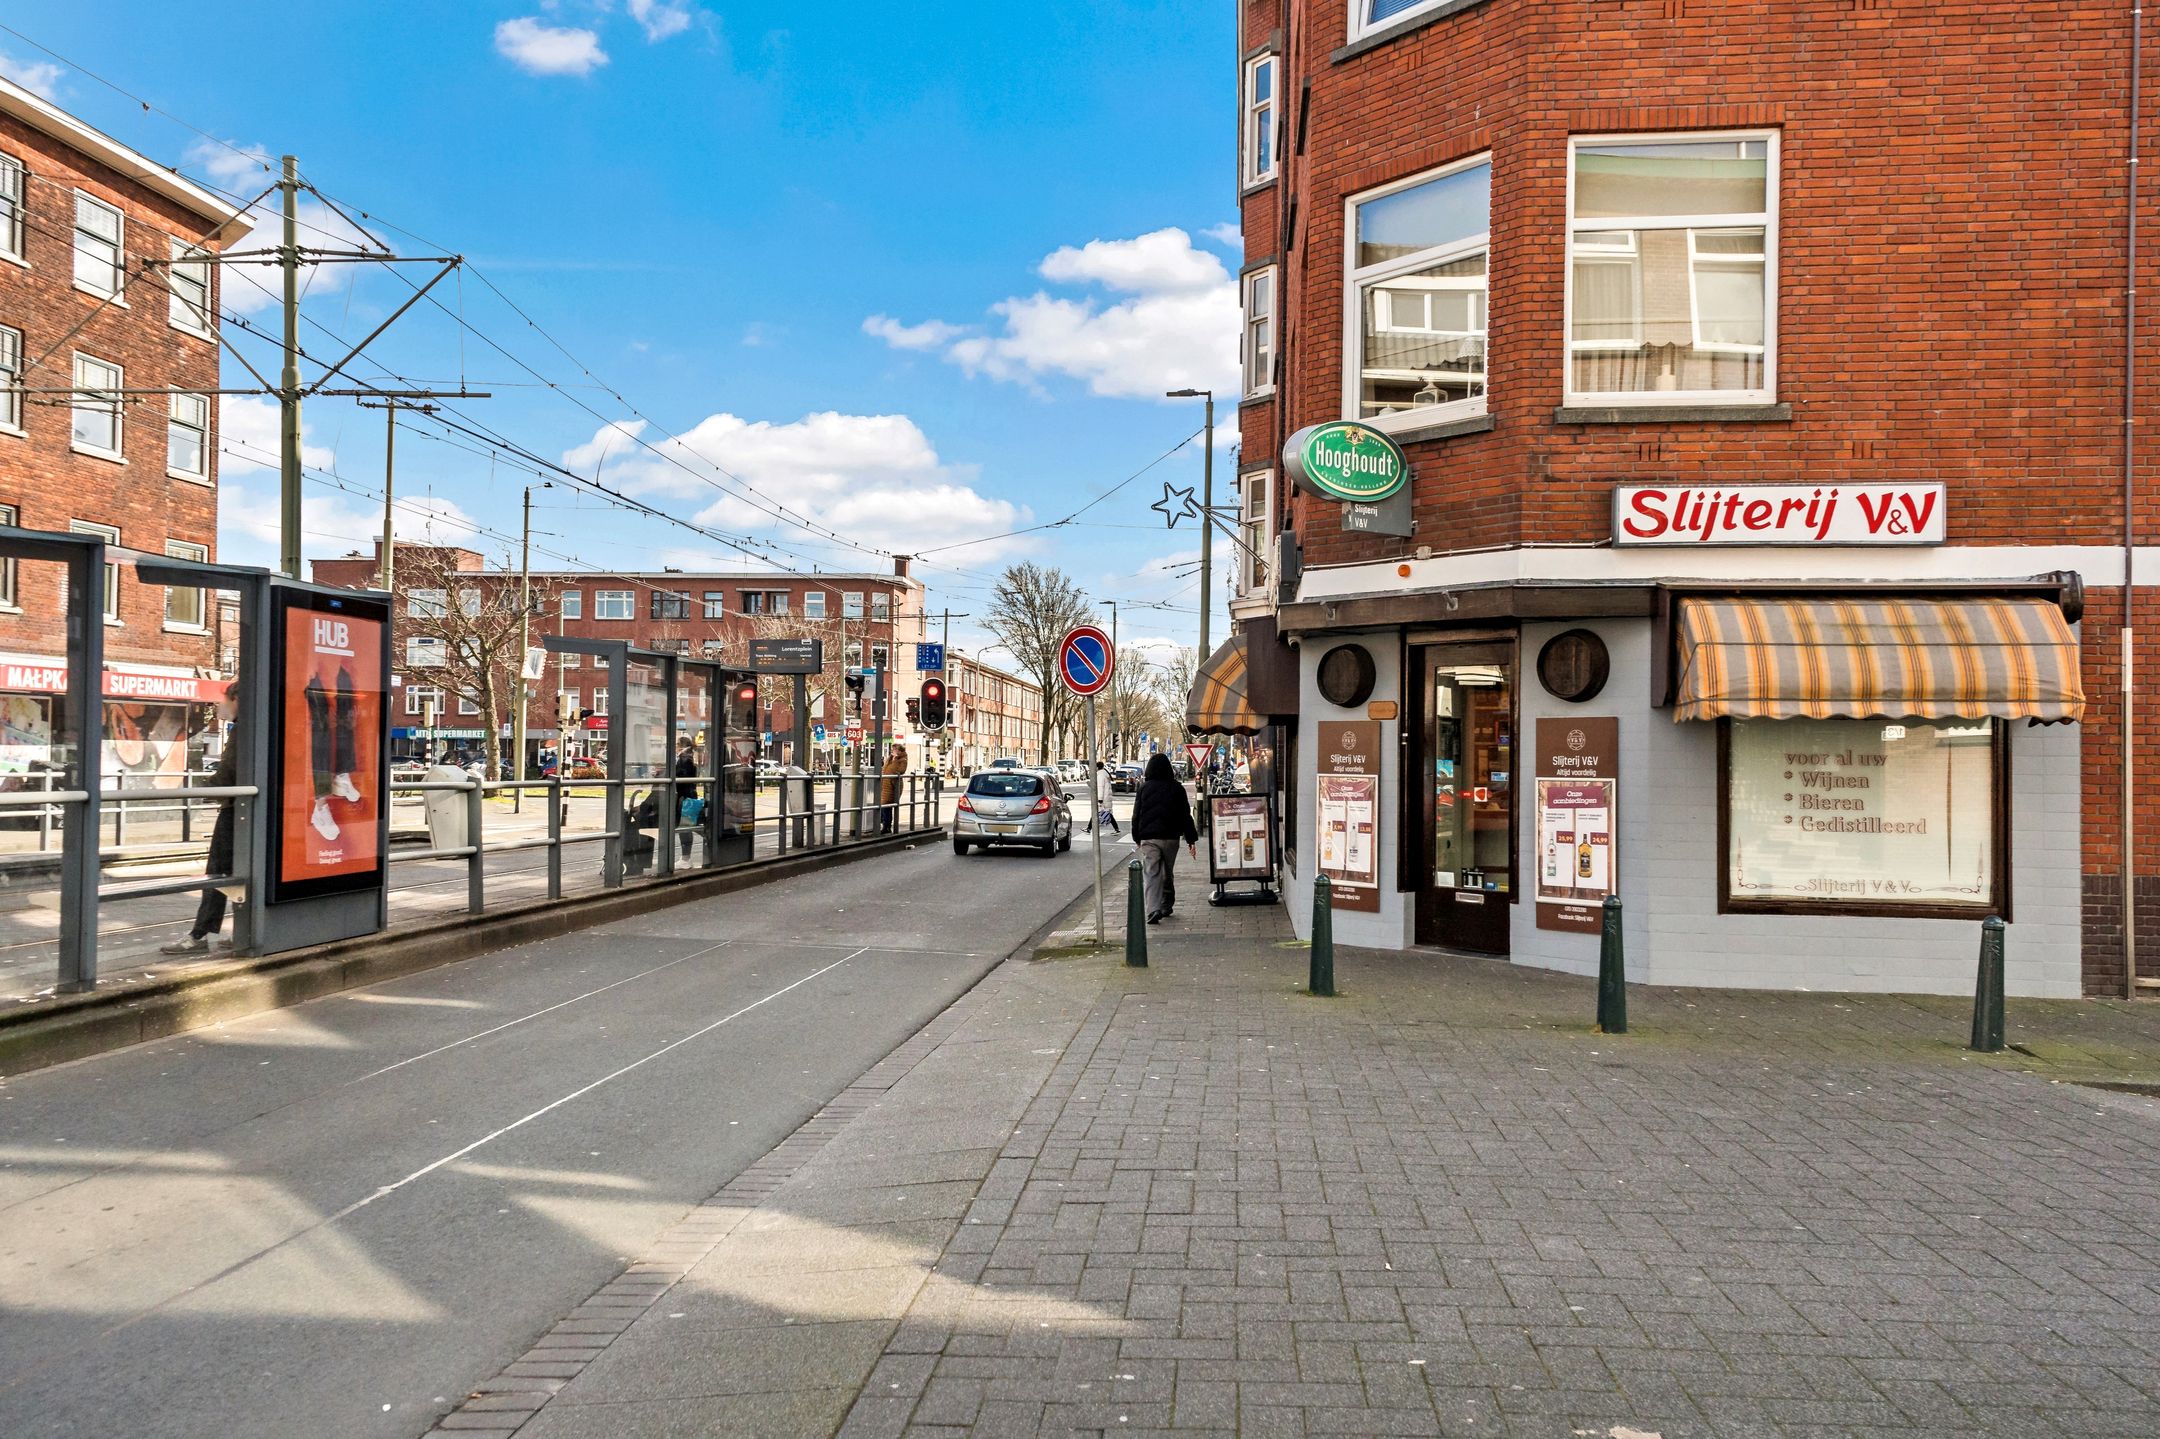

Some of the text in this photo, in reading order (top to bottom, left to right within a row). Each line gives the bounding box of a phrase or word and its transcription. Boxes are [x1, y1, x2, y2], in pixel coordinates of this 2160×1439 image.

[1316, 440, 1393, 477] Hooghoudt
[1354, 504, 1378, 517] Slijterij
[1623, 488, 1937, 541] Slijterij V&V
[1354, 518, 1369, 528] V&V
[314, 618, 349, 648] HUB
[7, 667, 198, 698] MAŁPK SUPERMARKT
[434, 729, 485, 738] SUPERMARKET
[847, 730, 861, 738] 603
[1330, 754, 1366, 765] Slijterij V&V
[1552, 755, 1598, 767] Slijterij V&V
[1784, 750, 1888, 767] voor al uw
[1345, 766, 1364, 774] voordelig
[1556, 768, 1597, 777] Altijd voordelig
[1799, 771, 1870, 791] Wijnen
[1552, 797, 1598, 805] aanbiedingen
[1799, 793, 1865, 811] Bieren
[1800, 816, 1927, 834] Gedistilleerd
[1808, 878, 1912, 896] Slijterij V & V
